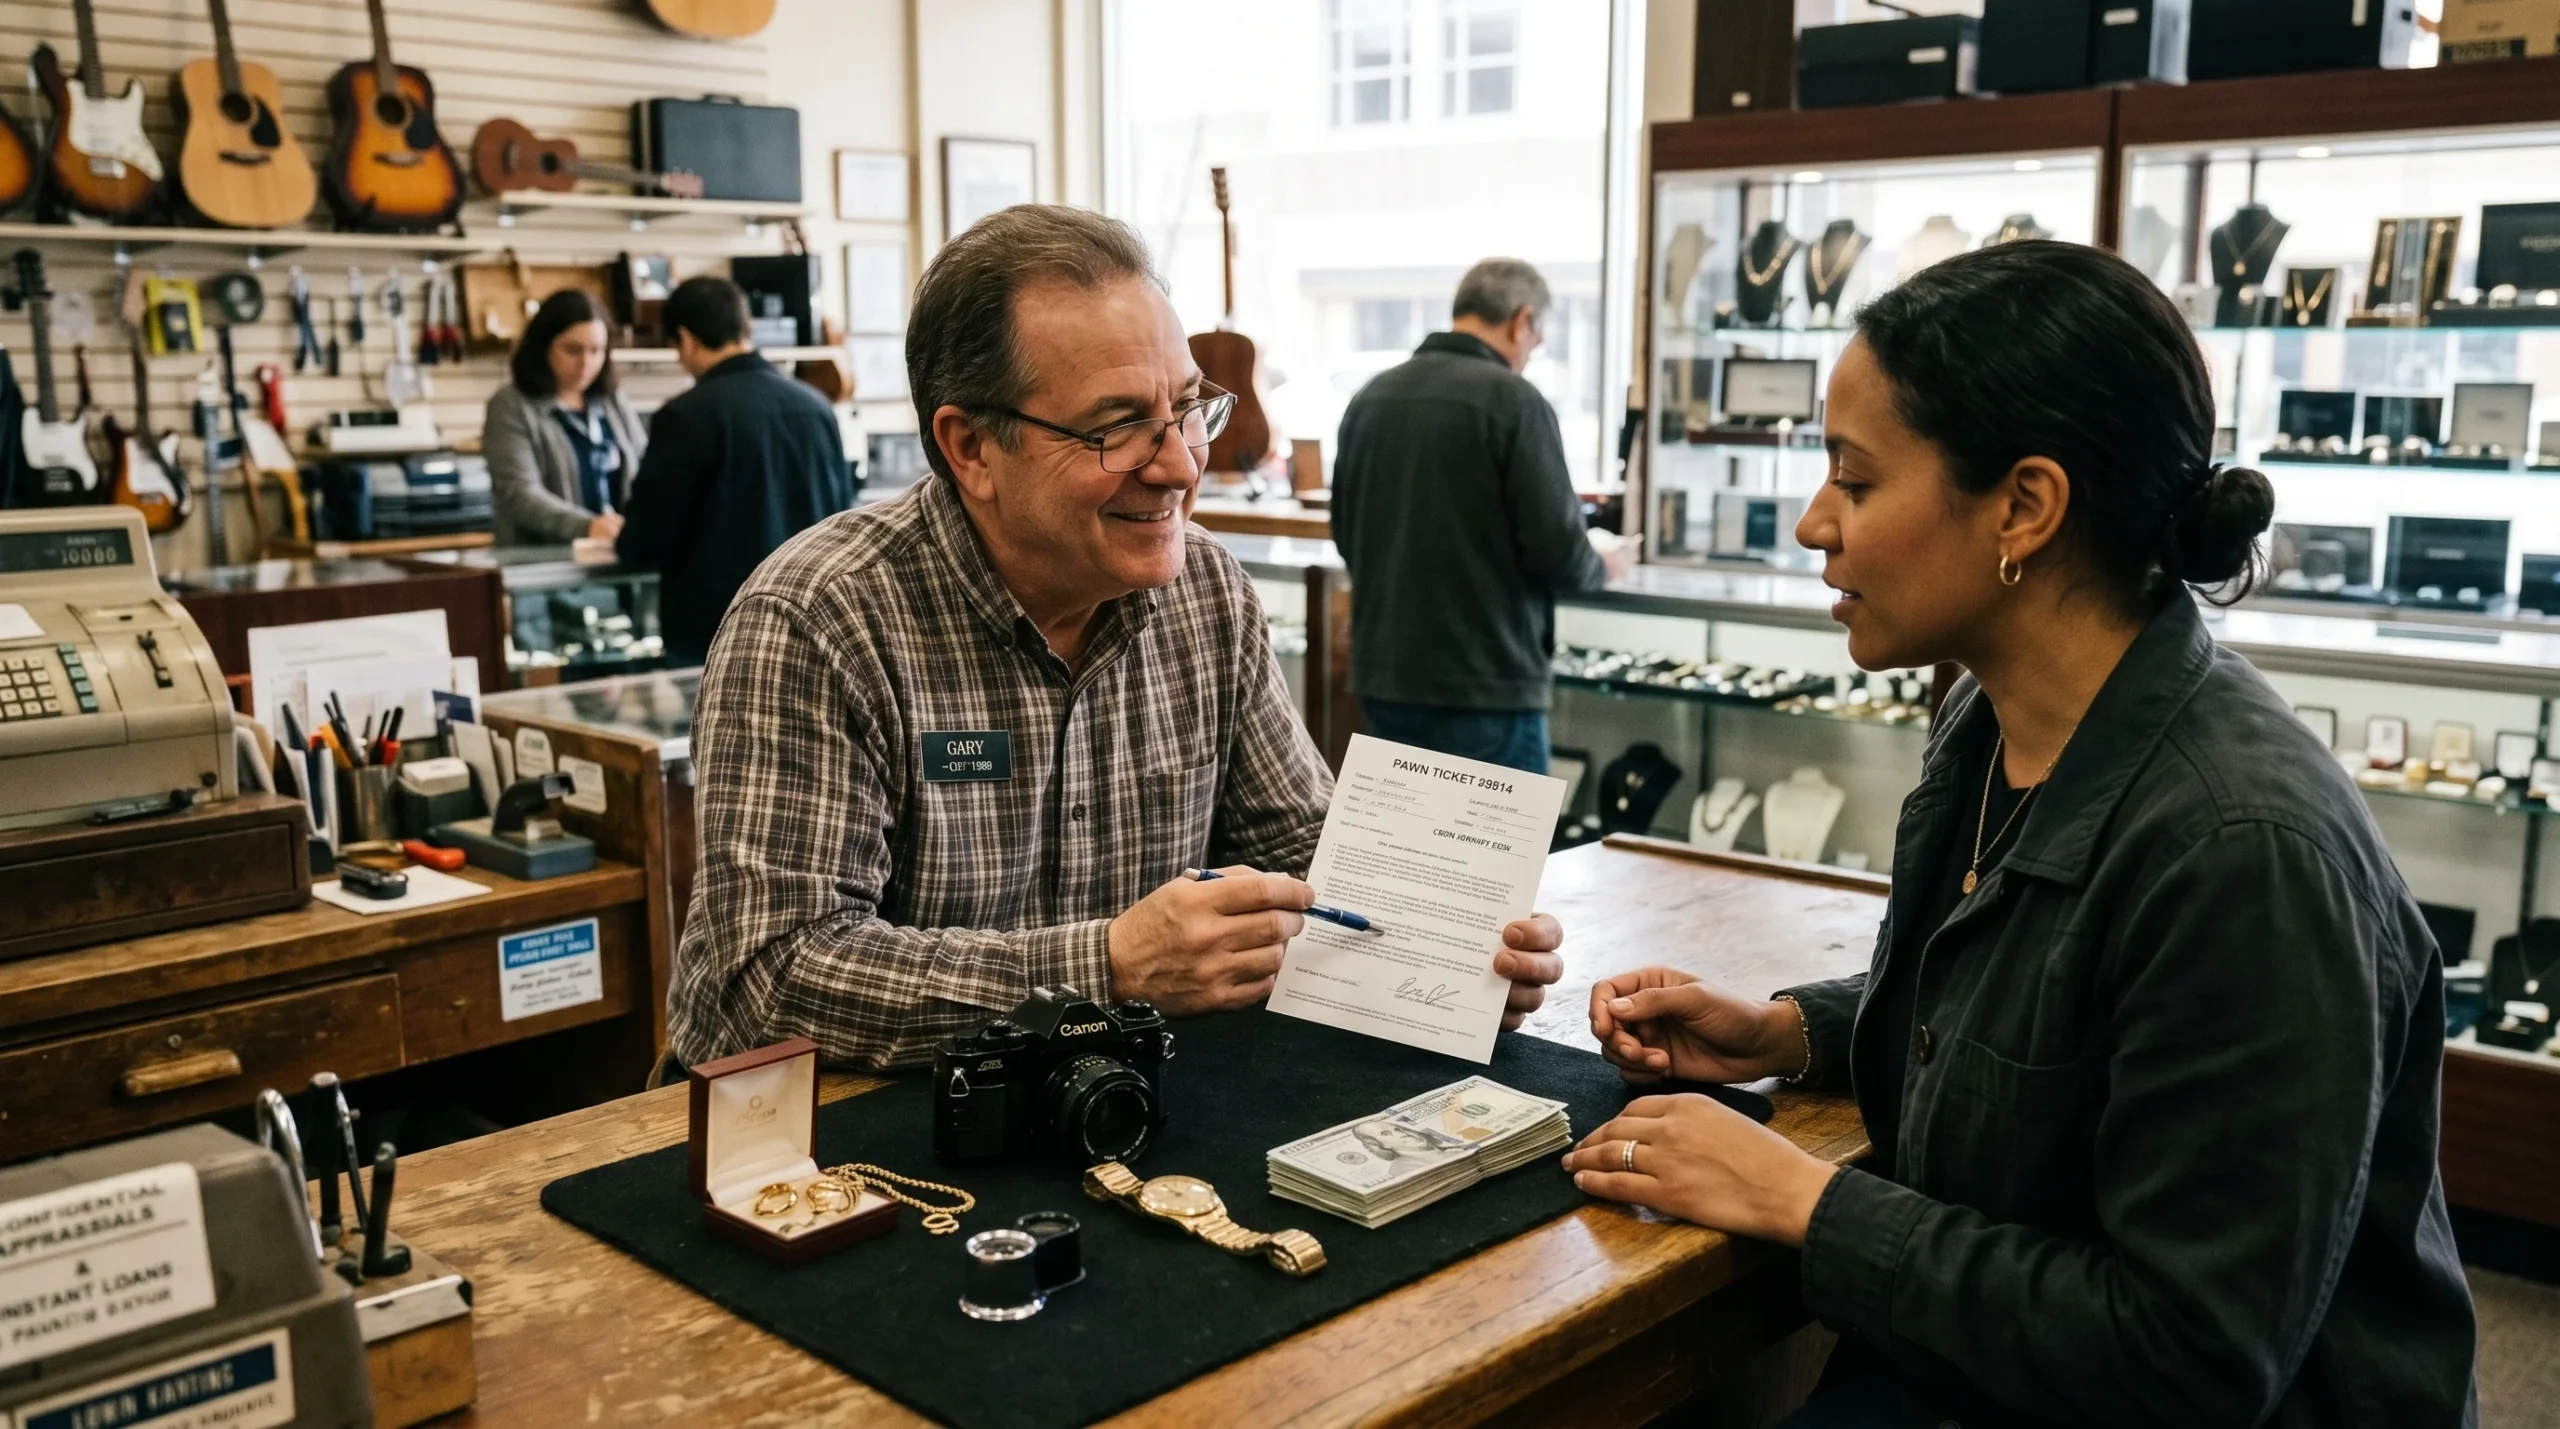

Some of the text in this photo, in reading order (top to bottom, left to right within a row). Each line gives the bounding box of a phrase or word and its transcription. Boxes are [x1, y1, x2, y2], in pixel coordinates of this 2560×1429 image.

[946, 740, 985, 756] GARY
[1392, 758, 1430, 776] PAWN
[1432, 767, 1476, 786] TICKET
[1059, 1021, 1109, 1037] Canon
[0, 1183, 166, 1234] ONFIDENTIAL
[102, 1262, 173, 1295] LOANS
